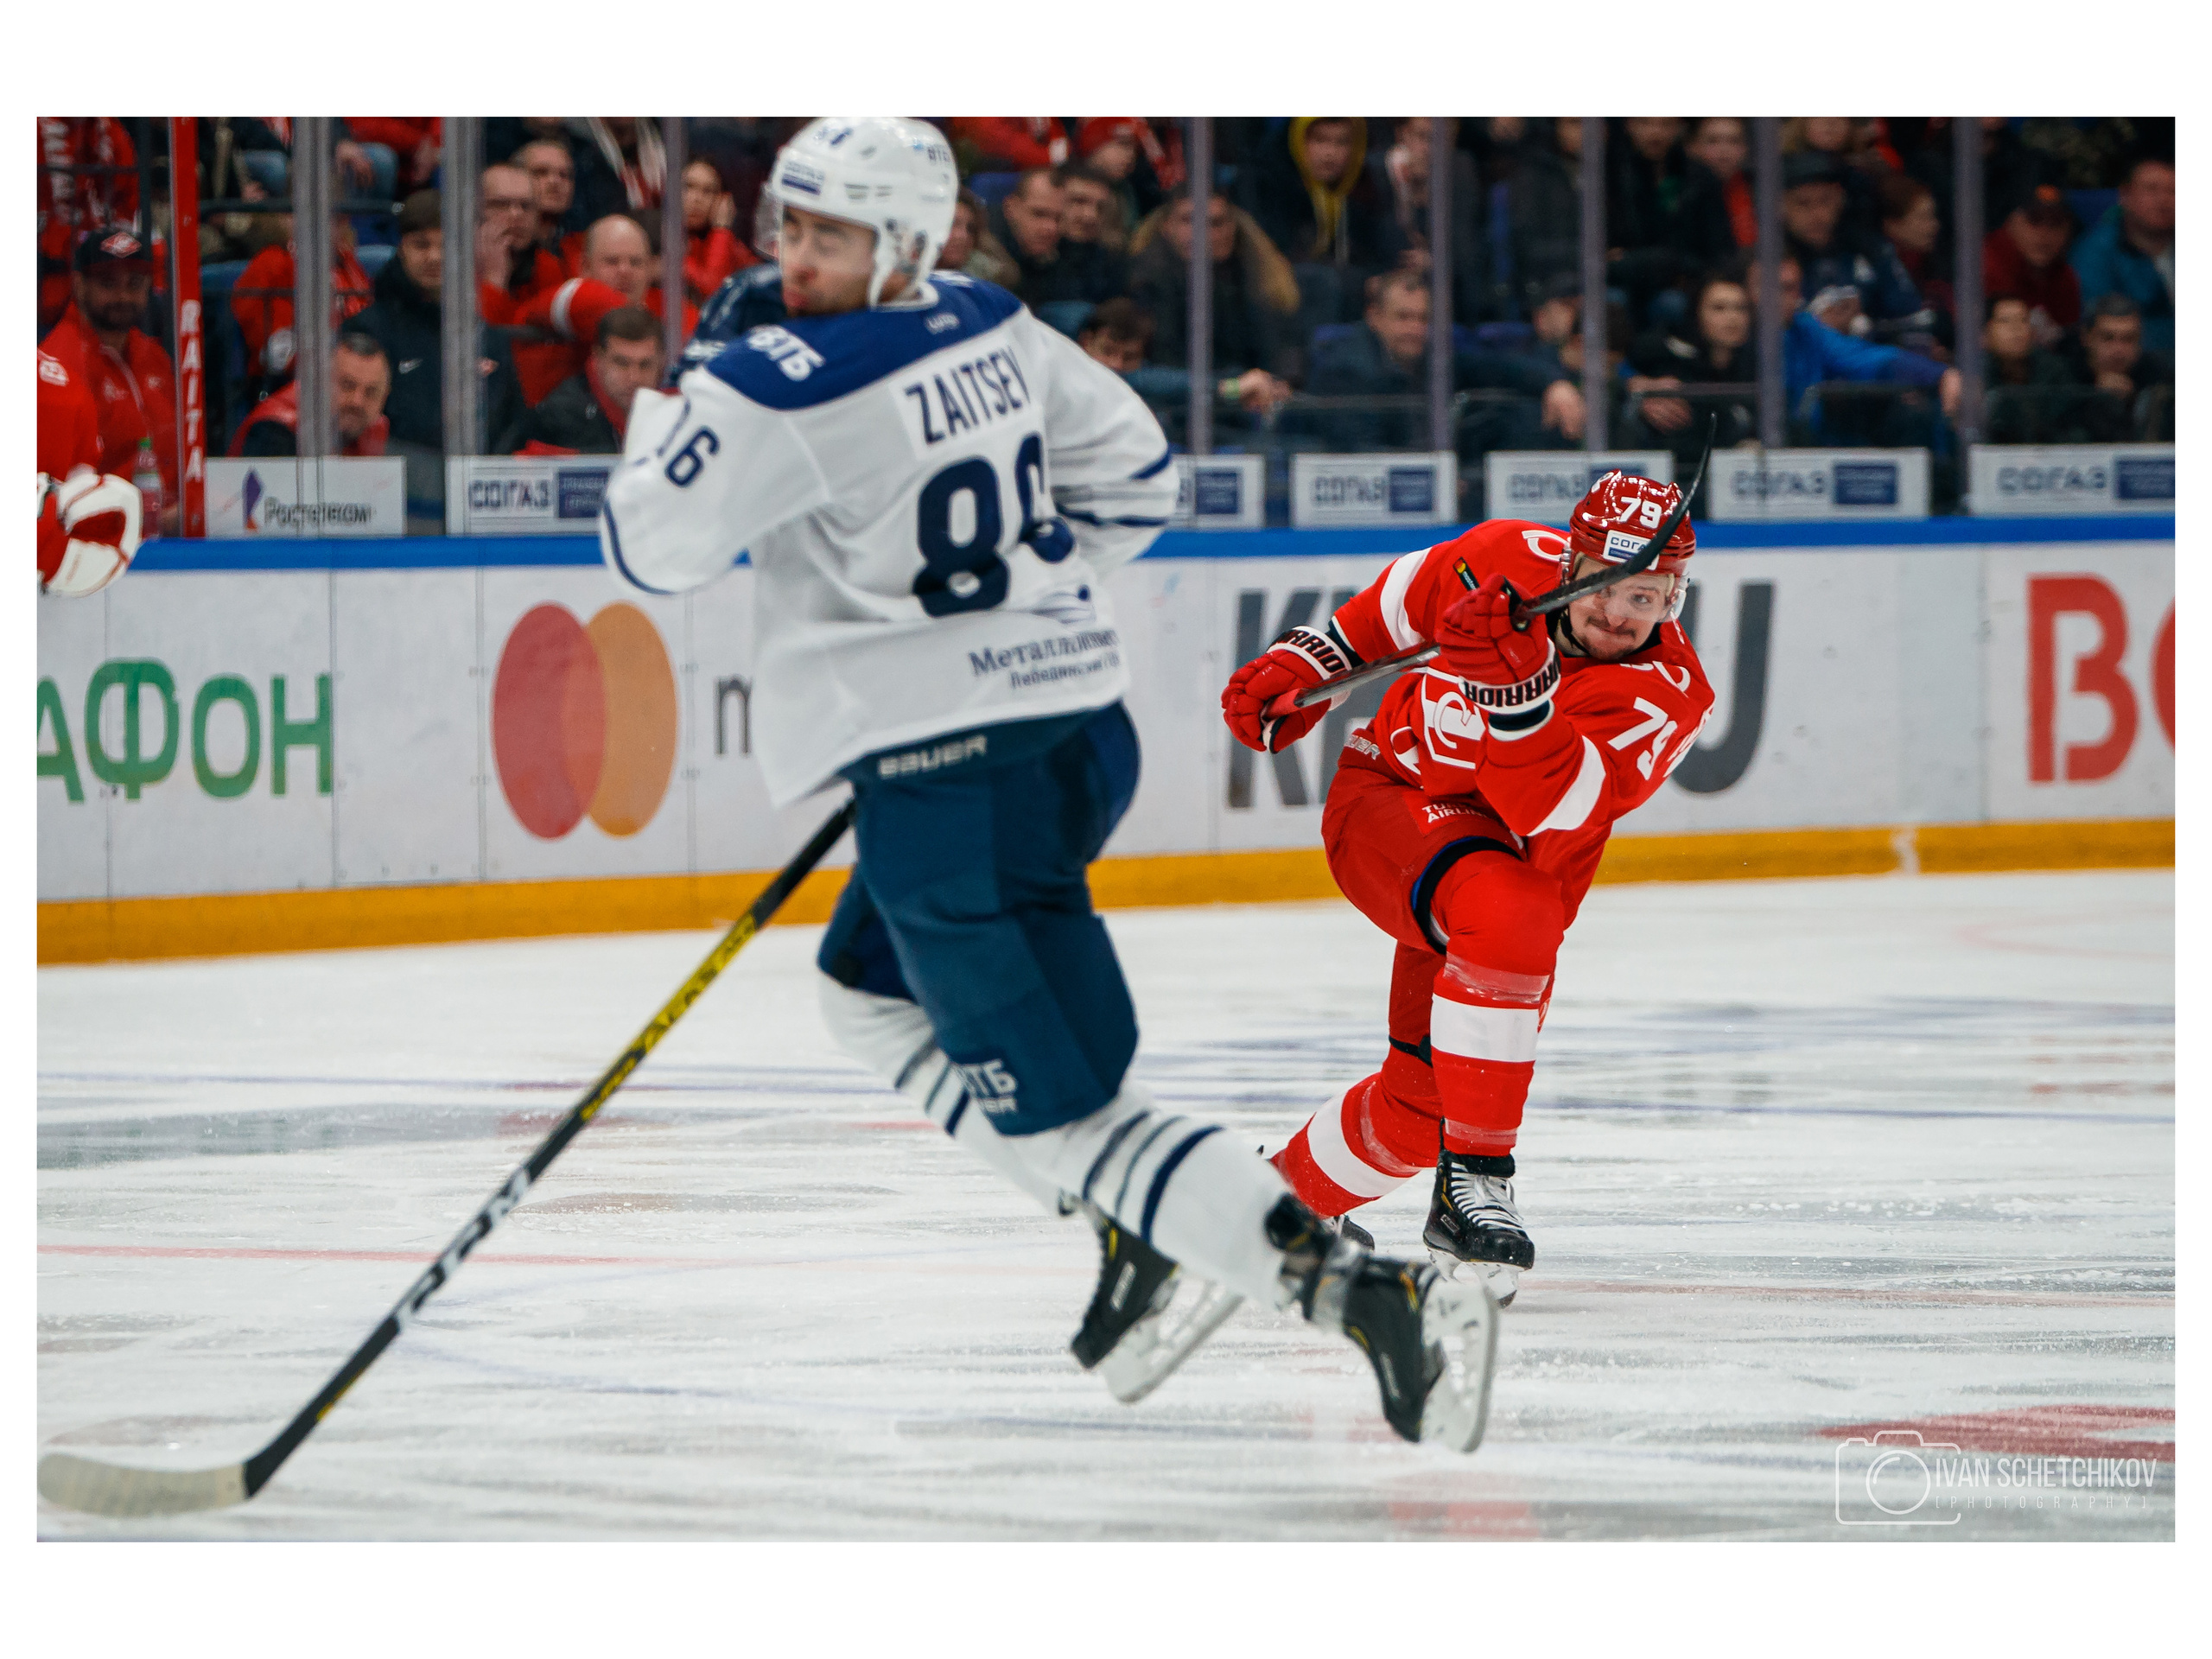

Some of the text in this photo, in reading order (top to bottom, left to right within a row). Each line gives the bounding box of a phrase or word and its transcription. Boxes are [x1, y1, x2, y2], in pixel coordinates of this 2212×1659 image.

[180, 300, 202, 482] RAITA
[905, 346, 1031, 446] ZAITSEV
[1618, 496, 1662, 530] 79
[877, 734, 988, 779] BAUER
